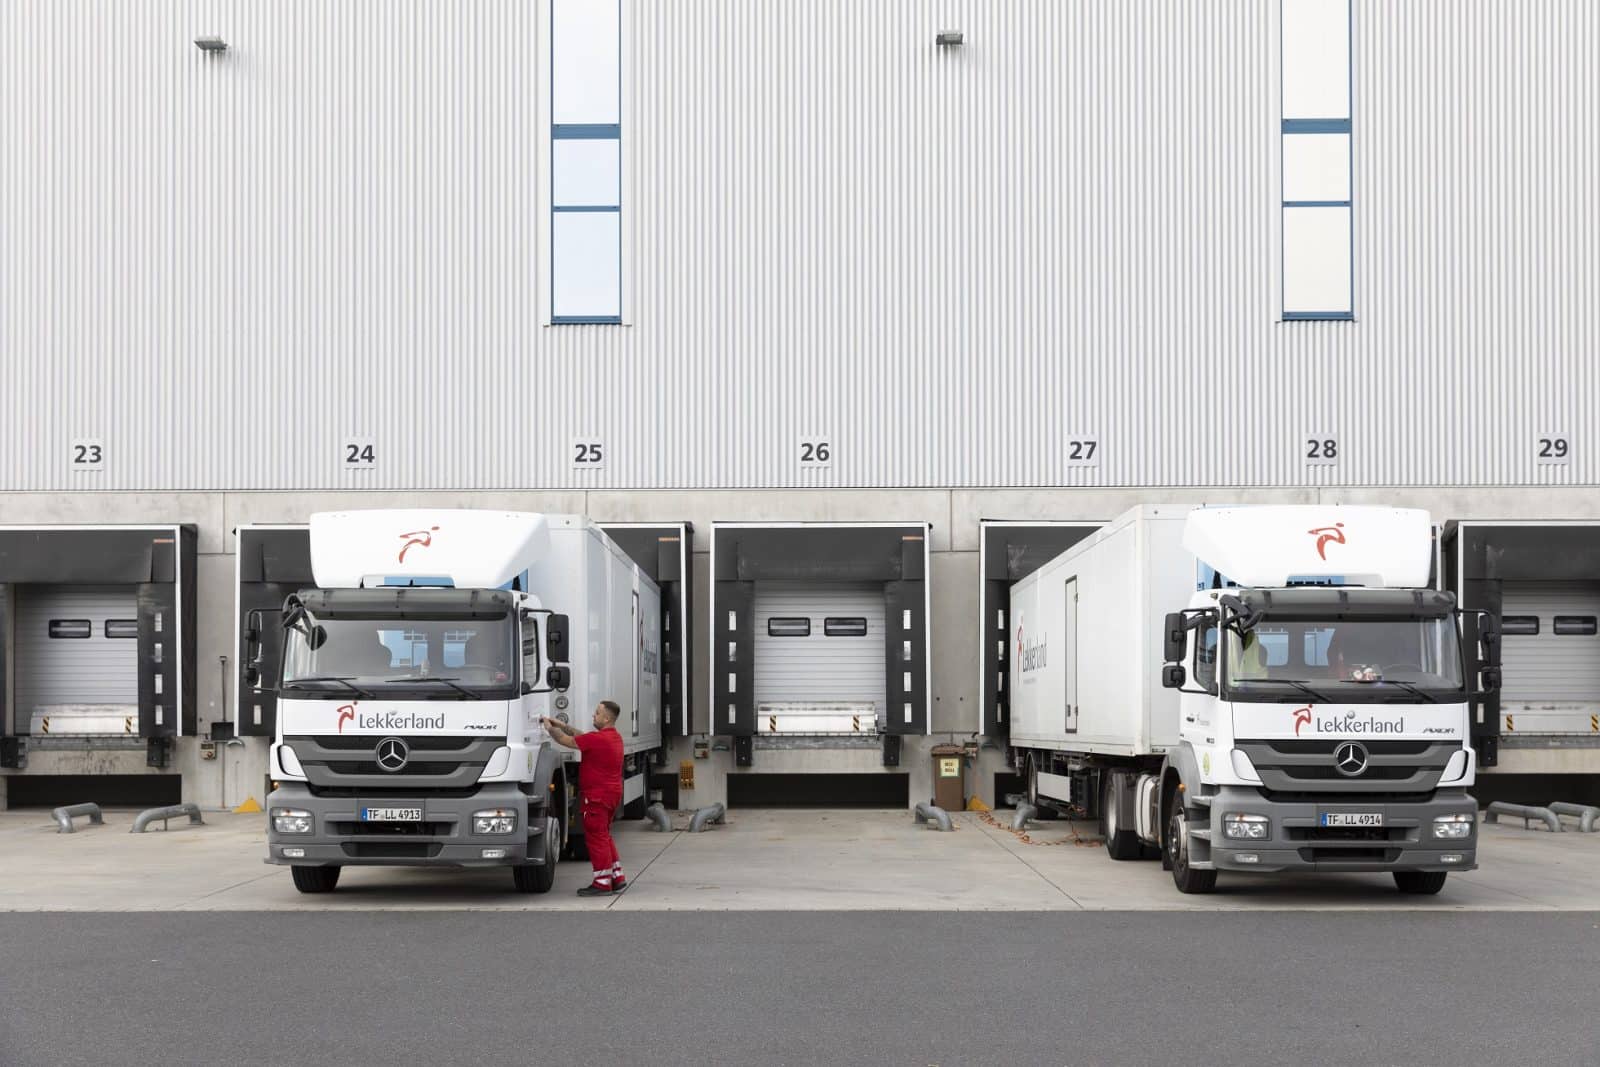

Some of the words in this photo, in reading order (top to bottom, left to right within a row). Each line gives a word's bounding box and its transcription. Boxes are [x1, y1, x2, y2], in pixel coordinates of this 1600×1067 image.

[73, 444, 102, 464] 23
[346, 444, 375, 463] 24
[574, 444, 603, 463] 25
[801, 443, 830, 461] 26
[1069, 441, 1097, 460] 27
[1307, 439, 1337, 458] 28
[1539, 438, 1568, 458] 29
[359, 712, 445, 729] Lekkerland
[1316, 716, 1404, 734] Lekkerland
[367, 809, 380, 820] TF
[385, 809, 397, 820] LL
[398, 809, 421, 820] 4913
[1328, 814, 1340, 825] TF
[1345, 815, 1357, 825] LL
[1358, 815, 1381, 825] 4914
